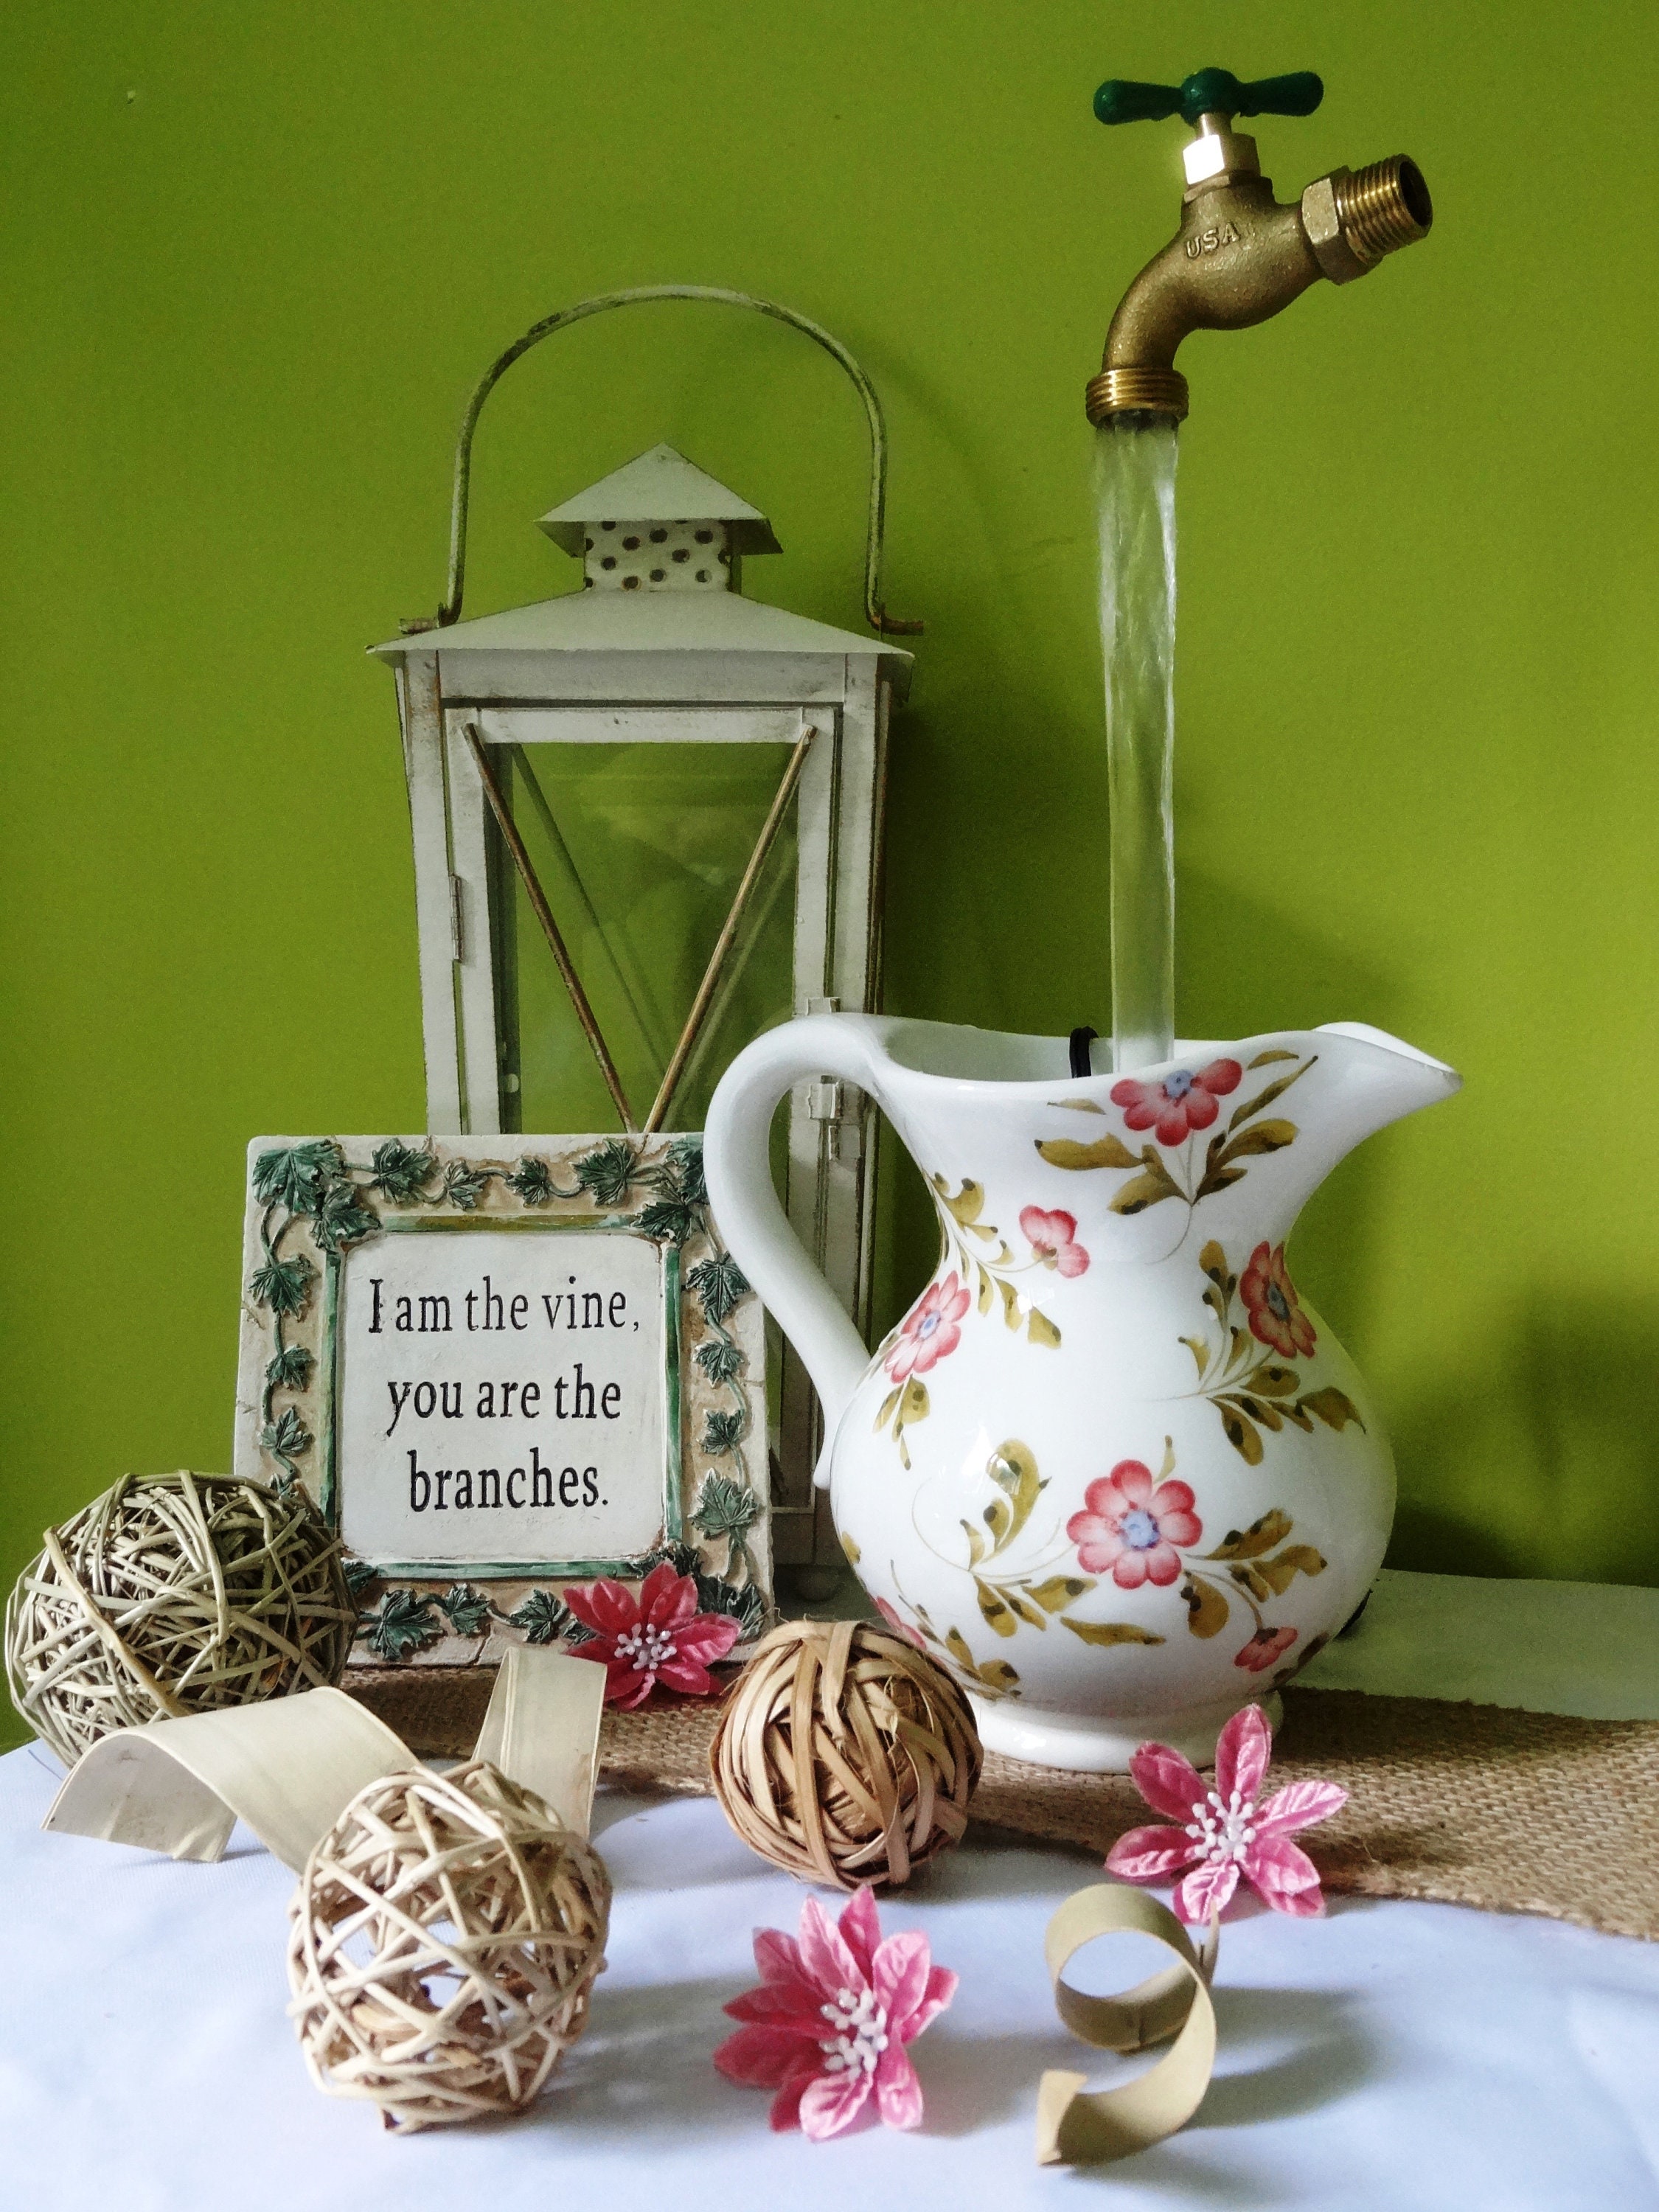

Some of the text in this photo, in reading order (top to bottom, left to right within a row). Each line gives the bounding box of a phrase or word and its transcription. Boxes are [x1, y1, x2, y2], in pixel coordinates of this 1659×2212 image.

[1186, 221, 1240, 259] USA
[368, 1275, 640, 1334] I am the vine,
[386, 1363, 621, 1437] you are the
[406, 1447, 609, 1513] branches.
